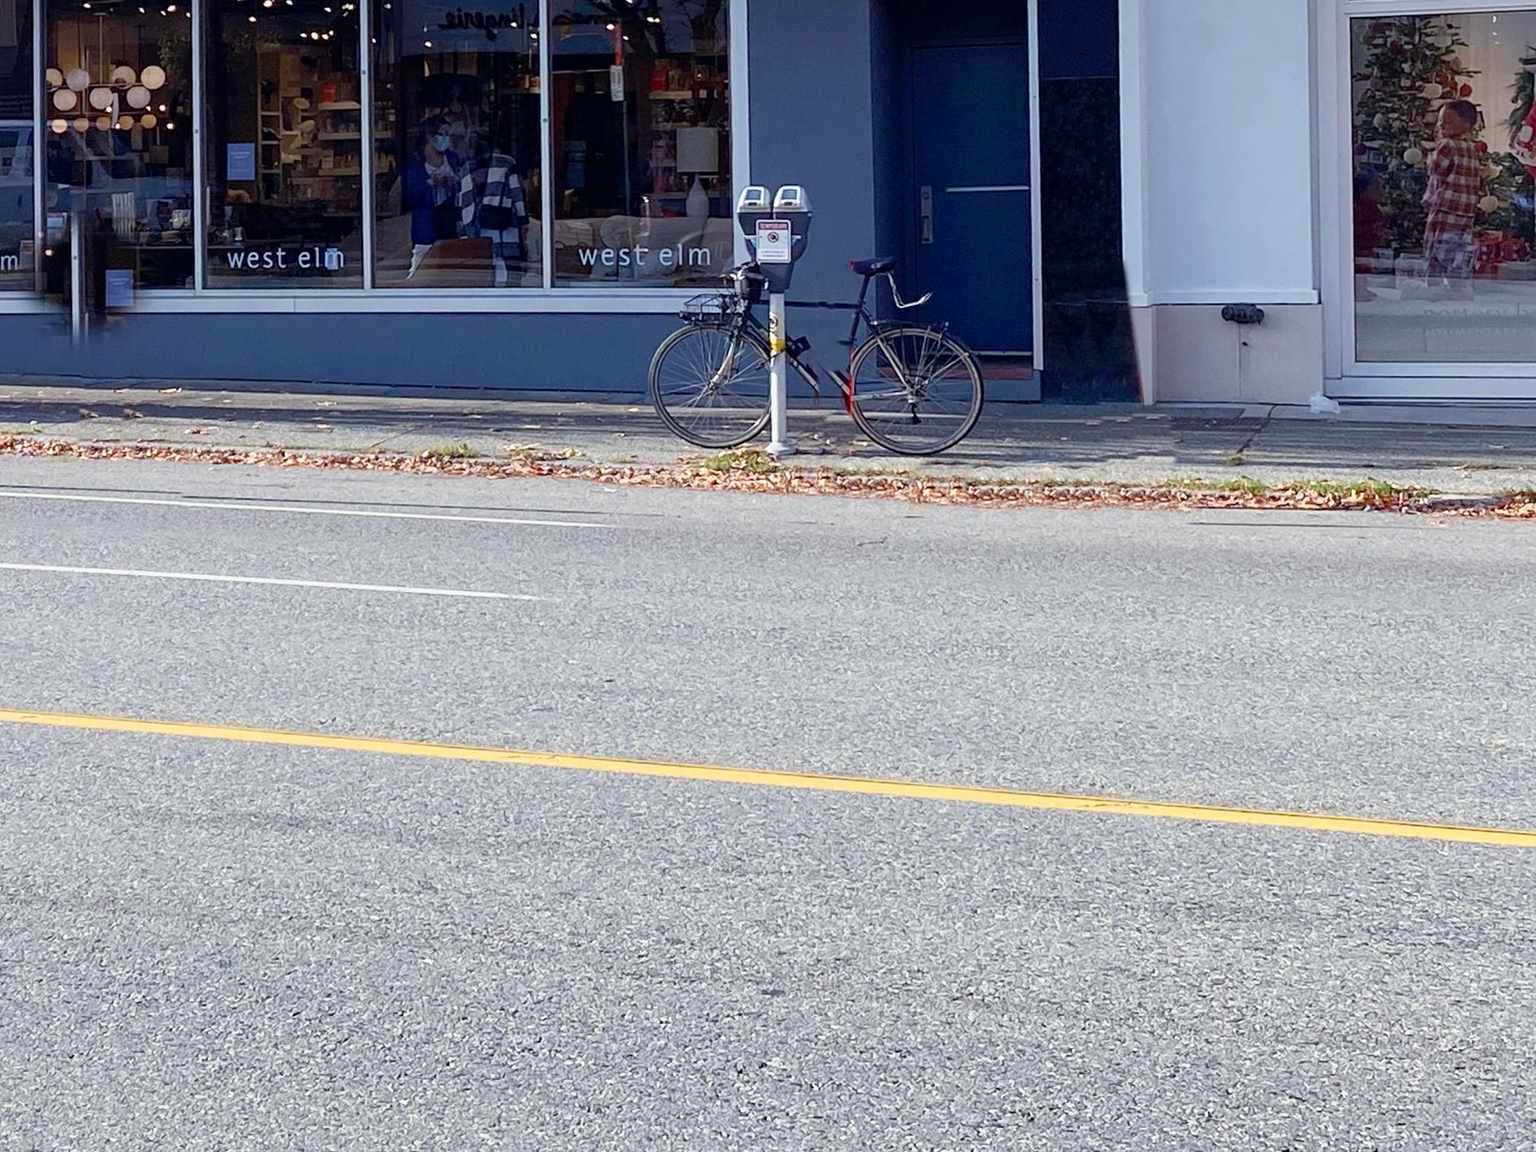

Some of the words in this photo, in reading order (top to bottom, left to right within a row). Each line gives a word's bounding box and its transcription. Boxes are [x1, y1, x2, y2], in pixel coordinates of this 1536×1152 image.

[227, 247, 287, 269] west
[298, 247, 345, 269] elm
[578, 244, 648, 266] west
[659, 243, 711, 266] elm
